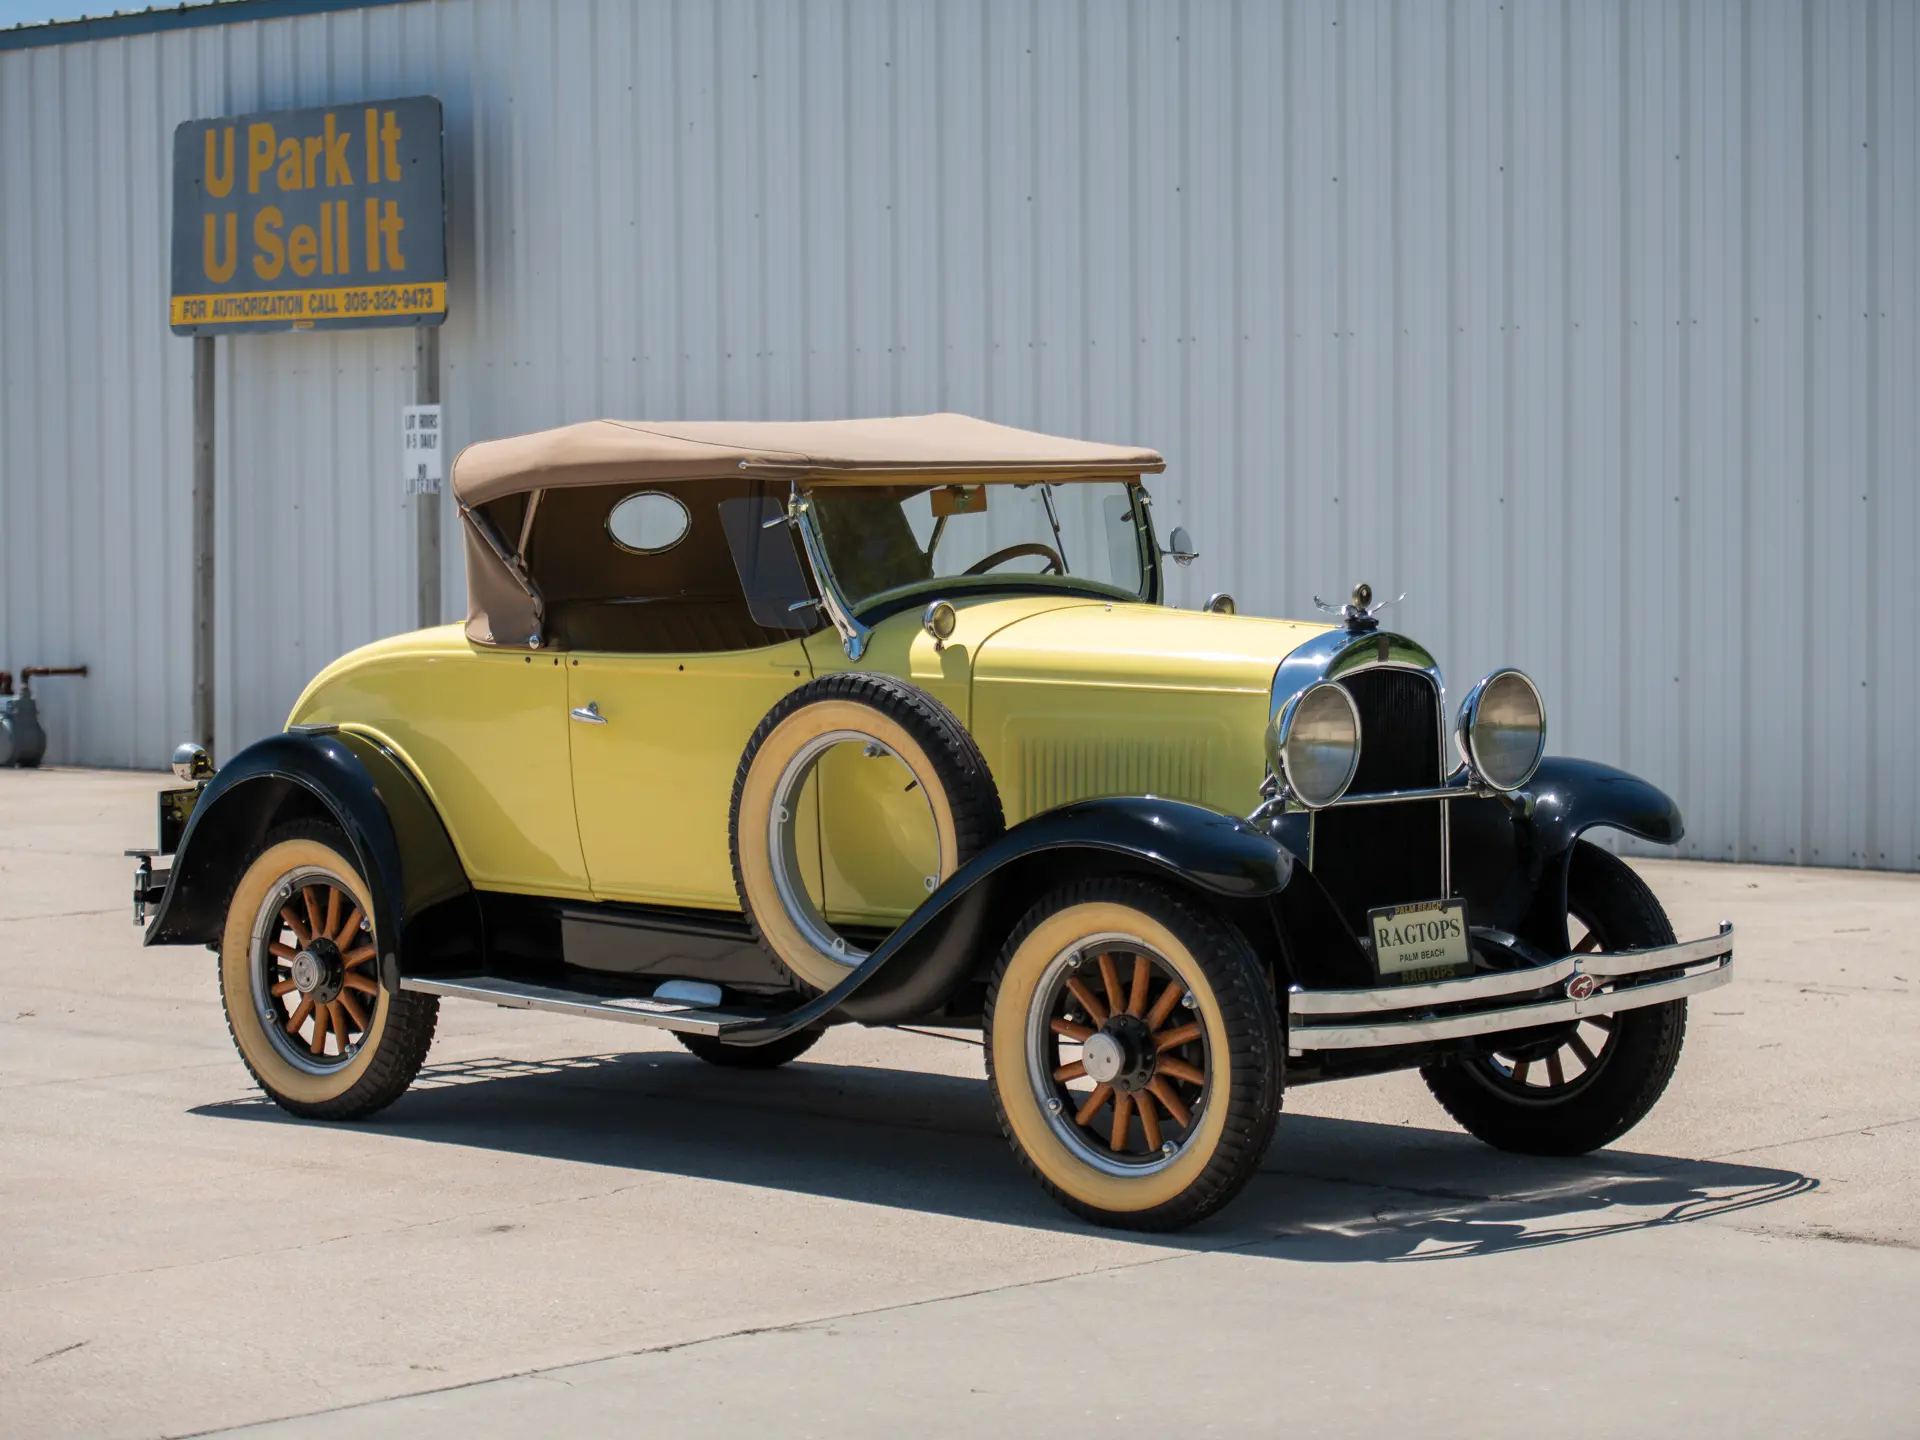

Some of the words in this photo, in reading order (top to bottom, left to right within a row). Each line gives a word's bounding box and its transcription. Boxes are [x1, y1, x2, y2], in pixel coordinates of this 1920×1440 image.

[205, 126, 234, 198] U
[248, 112, 354, 193] Park
[365, 108, 401, 184] It
[204, 212, 237, 283] U
[253, 200, 349, 281] Sell
[365, 197, 405, 272] It
[183, 300, 206, 320] FOR
[212, 295, 303, 318] AUTHORIZATION
[308, 293, 338, 313] CALL
[344, 287, 433, 312] 308-382-9473
[1395, 905, 1416, 915] PALM
[1418, 901, 1442, 912] BEACH
[1378, 918, 1461, 948] RAGTOPS
[1400, 952, 1419, 962] PALM
[1421, 948, 1445, 960] BEACH
[1402, 965, 1456, 984] RAGTOPS
